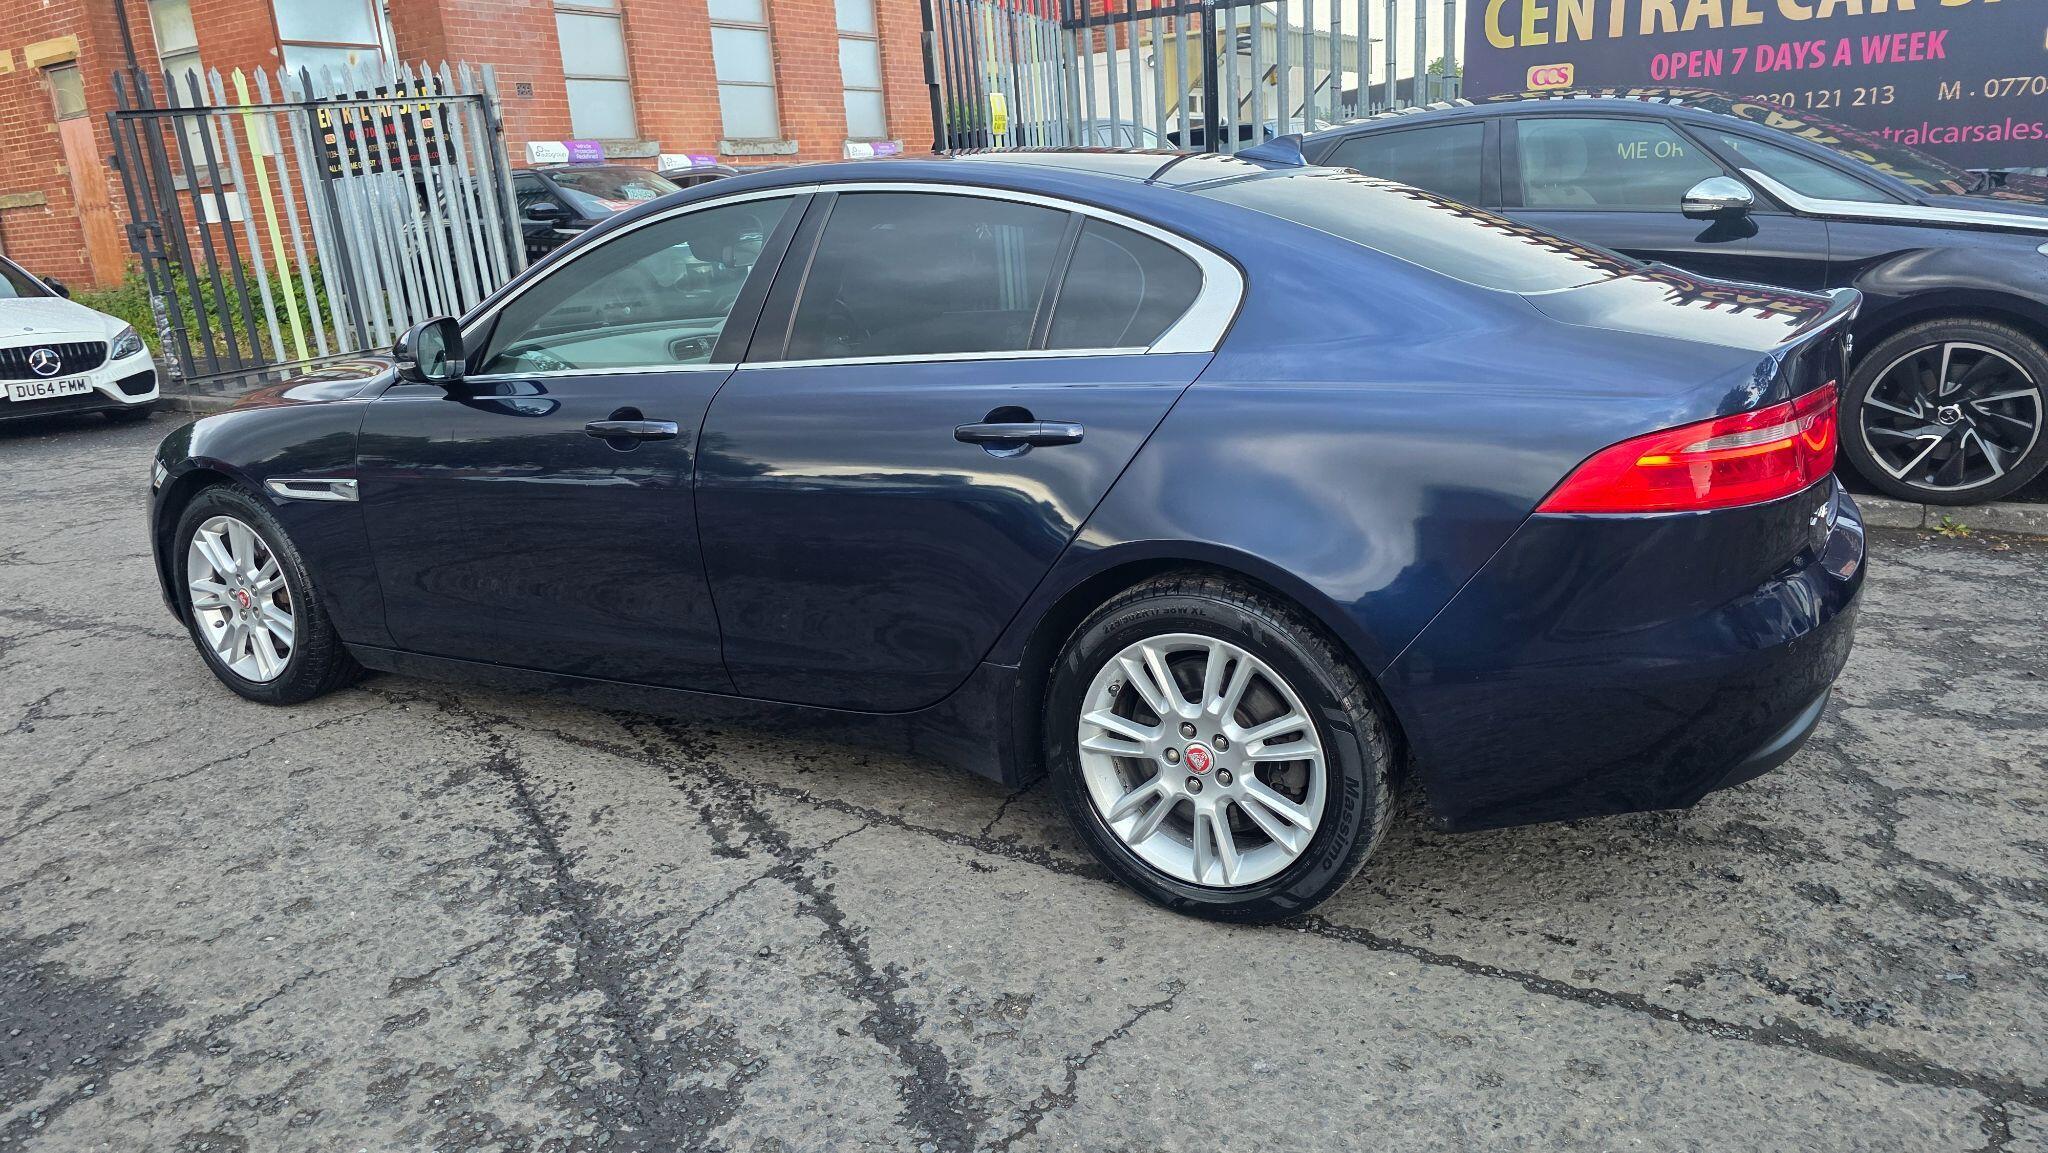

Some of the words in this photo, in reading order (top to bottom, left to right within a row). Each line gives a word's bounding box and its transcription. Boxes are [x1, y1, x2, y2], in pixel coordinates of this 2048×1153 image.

[1651, 48, 1723, 81] OPEN
[1731, 47, 1748, 75] 7
[1755, 39, 1826, 73] DAYS
[1832, 38, 1852, 67] A
[1861, 29, 1949, 64] WEEK
[1805, 89, 1842, 109] 121
[1851, 85, 1895, 106] 213
[1938, 80, 1961, 101] M
[1983, 75, 2048, 99] 0770
[16, 382, 55, 398] DU64
[59, 378, 87, 393] FMM
[1321, 775, 1361, 871] Massimo
